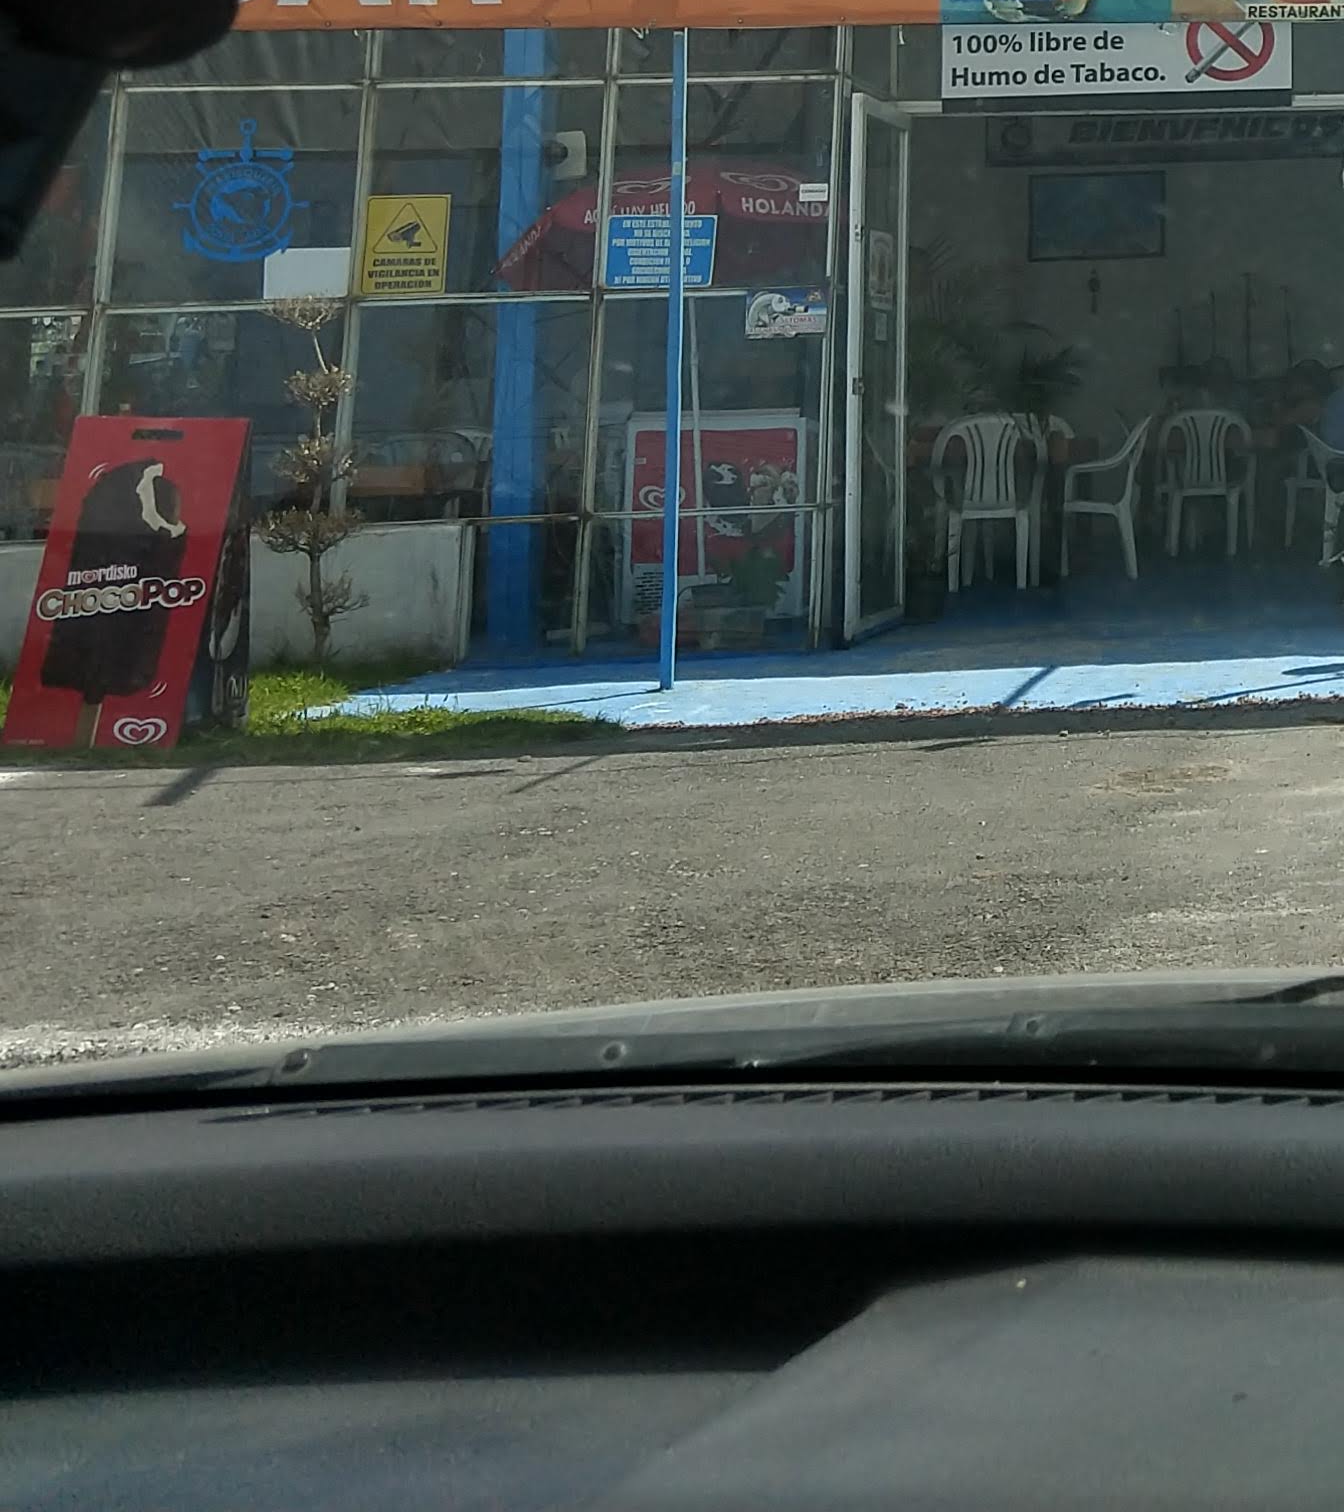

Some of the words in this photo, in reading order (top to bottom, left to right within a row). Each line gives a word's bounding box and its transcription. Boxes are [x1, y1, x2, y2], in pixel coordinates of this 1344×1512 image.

[951, 32, 1023, 54] 100%
[1029, 30, 1088, 53] libre
[1093, 29, 1124, 52] de
[951, 65, 1033, 88] Humo
[1034, 64, 1066, 86] de
[1070, 61, 1166, 85] Tabaco.
